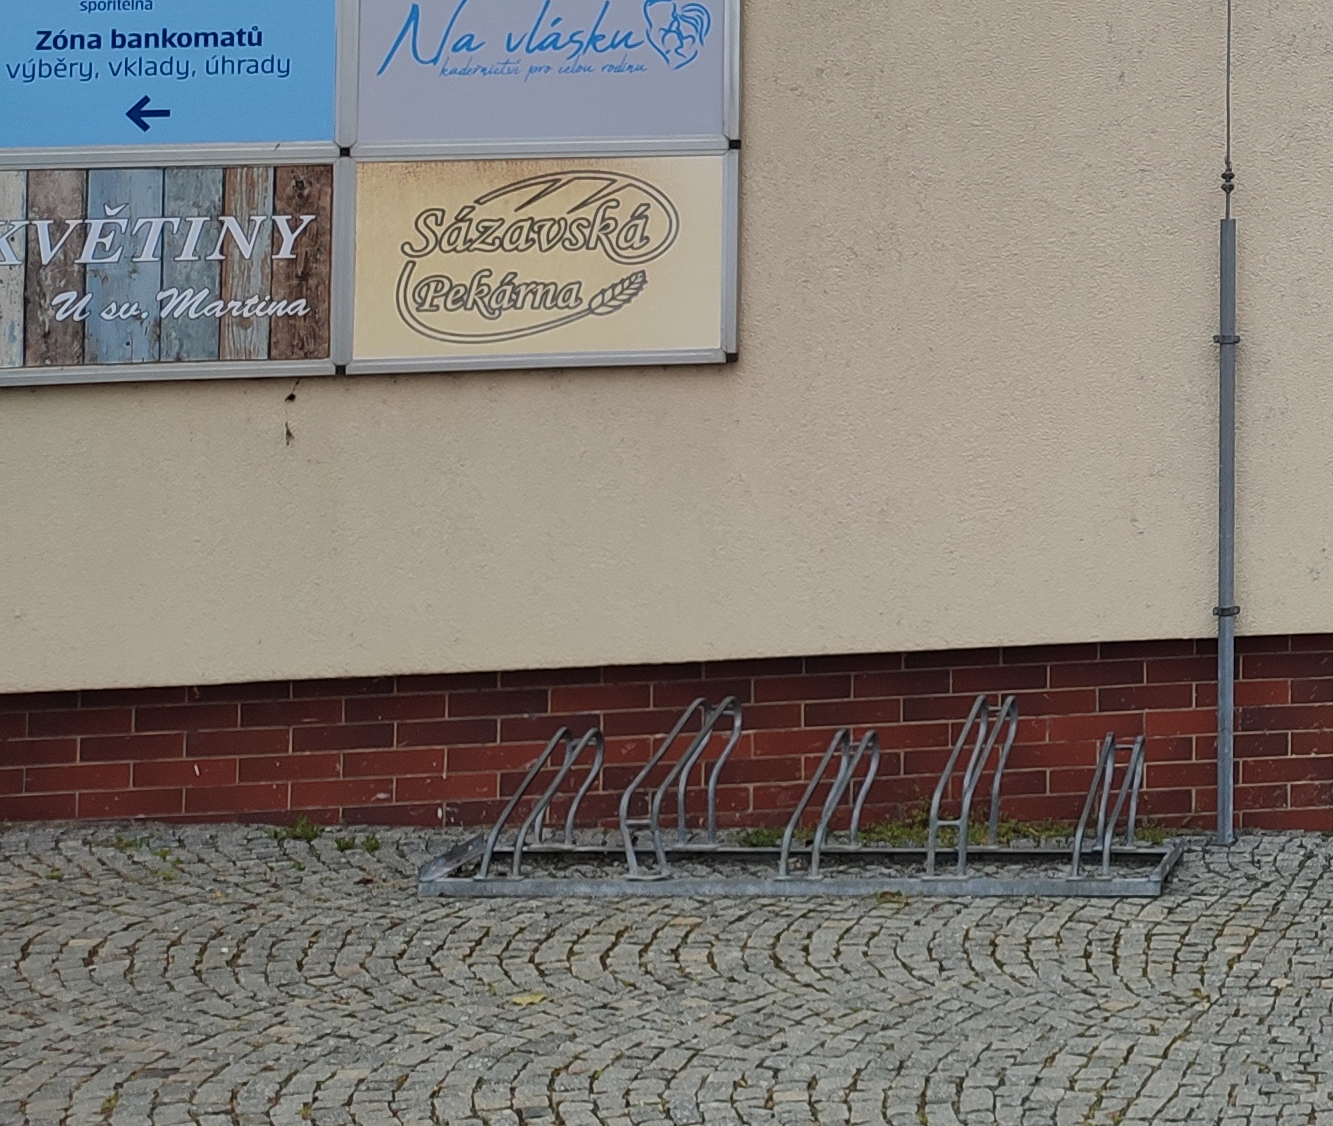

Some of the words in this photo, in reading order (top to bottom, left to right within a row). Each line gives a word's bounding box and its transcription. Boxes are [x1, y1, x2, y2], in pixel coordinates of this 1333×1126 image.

[35, 29, 102, 51] Zóna
[110, 26, 263, 49] bankomatů
[506, 0, 644, 60] vlásku
[6, 57, 100, 83] výběry,
[108, 56, 197, 80] vklady,
[205, 54, 291, 79] úhrady
[524, 63, 553, 82] pro
[557, 55, 596, 74] celou
[601, 53, 648, 74] rodinu
[0, 203, 317, 266] KVĚTINY
[400, 198, 652, 262] Sázavská
[51, 291, 91, 322] U
[100, 300, 149, 322] sv.
[156, 287, 312, 320] Martina
[412, 269, 584, 320] Pekárna
